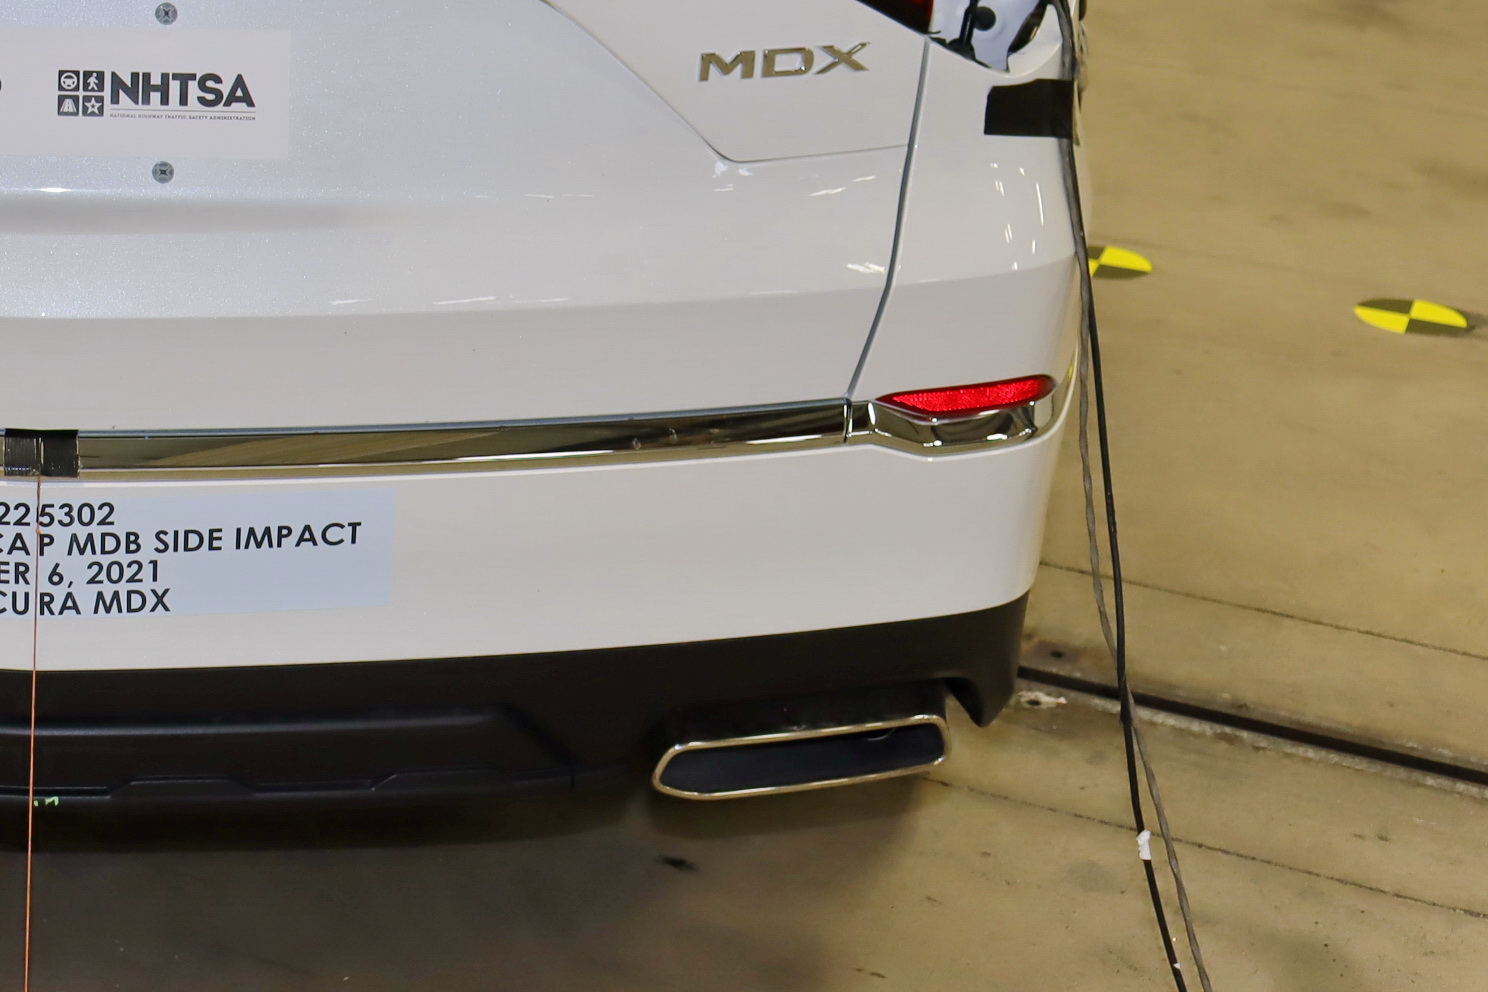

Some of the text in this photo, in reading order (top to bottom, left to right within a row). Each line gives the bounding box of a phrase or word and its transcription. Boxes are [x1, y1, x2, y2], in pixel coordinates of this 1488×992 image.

[698, 42, 870, 82] MDX
[110, 70, 256, 108] NHTSA
[67, 531, 141, 556] MDB
[153, 526, 223, 553] SIDE
[234, 520, 362, 550] IMPACT
[47, 560, 74, 591] 6,
[86, 558, 160, 585] 2021
[93, 587, 171, 614] MDX
